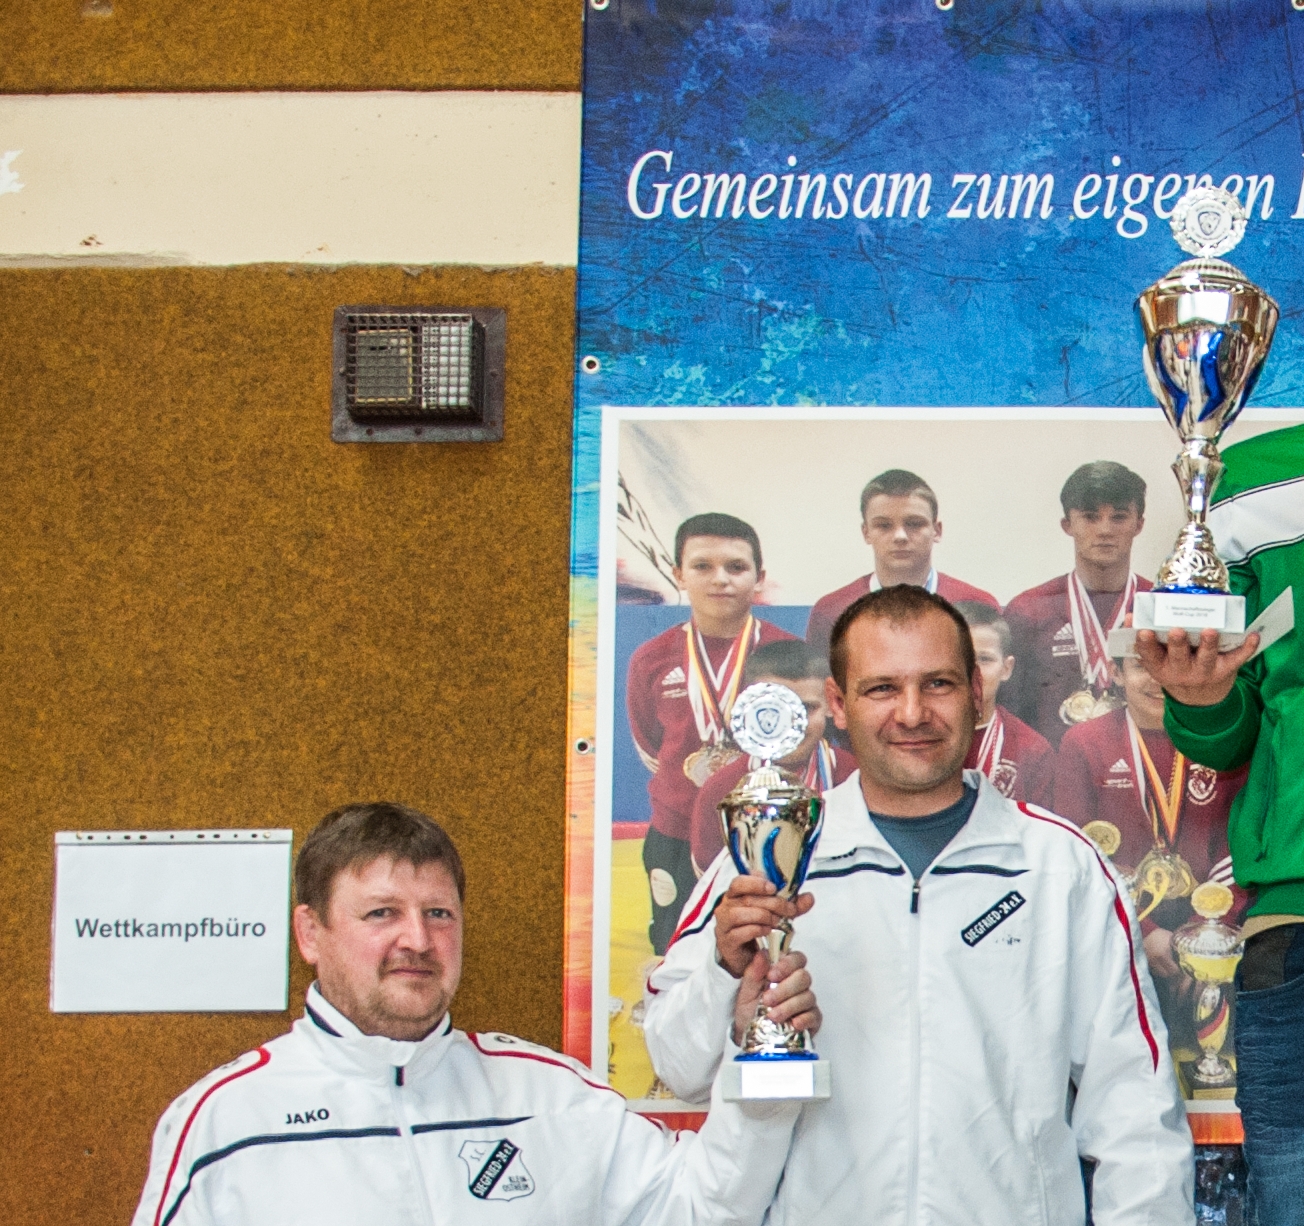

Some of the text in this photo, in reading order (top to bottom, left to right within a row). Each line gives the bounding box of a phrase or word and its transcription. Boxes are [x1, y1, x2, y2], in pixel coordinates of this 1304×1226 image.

[628, 151, 933, 221] Gemeinsam
[947, 174, 1055, 221] zum
[75, 917, 267, 943] Wettkampfbüro
[286, 1108, 330, 1125] JAKO
